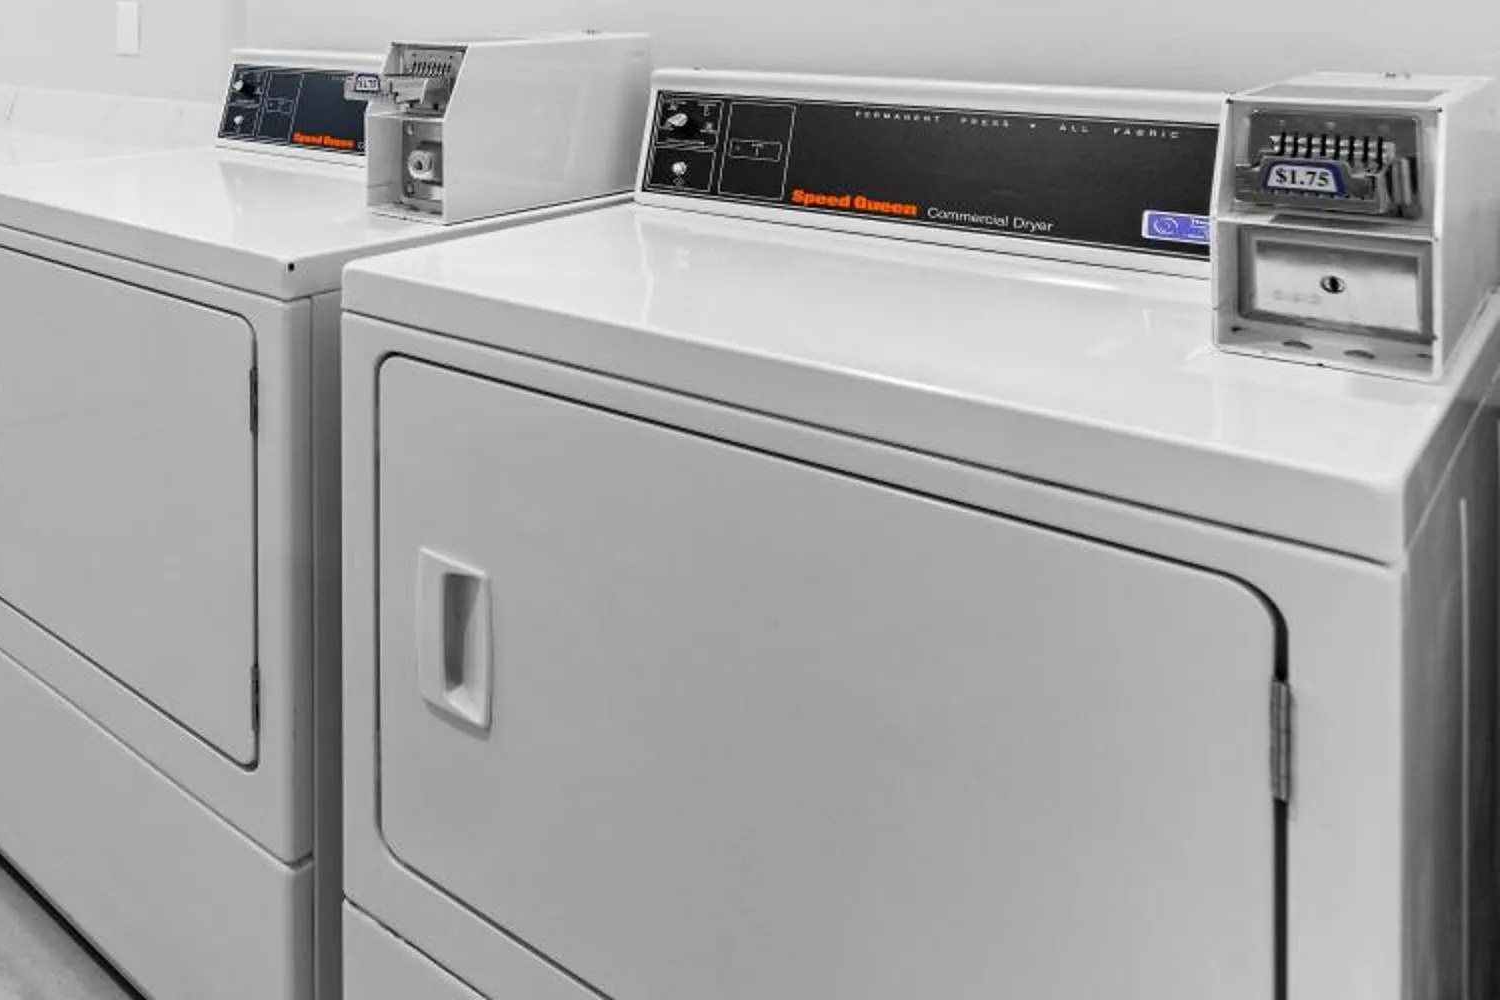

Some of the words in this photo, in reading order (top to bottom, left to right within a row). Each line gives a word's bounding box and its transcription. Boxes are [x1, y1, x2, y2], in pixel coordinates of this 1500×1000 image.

[959, 116, 1010, 128] PRESS
[1059, 123, 1089, 133] ALL
[1113, 127, 1180, 139] FABRIC
[1274, 167, 1330, 188] $1.75
[791, 188, 851, 209] Speed
[853, 194, 918, 216] Queen
[926, 207, 1009, 228] Commercial
[1012, 216, 1054, 232] Dryer
